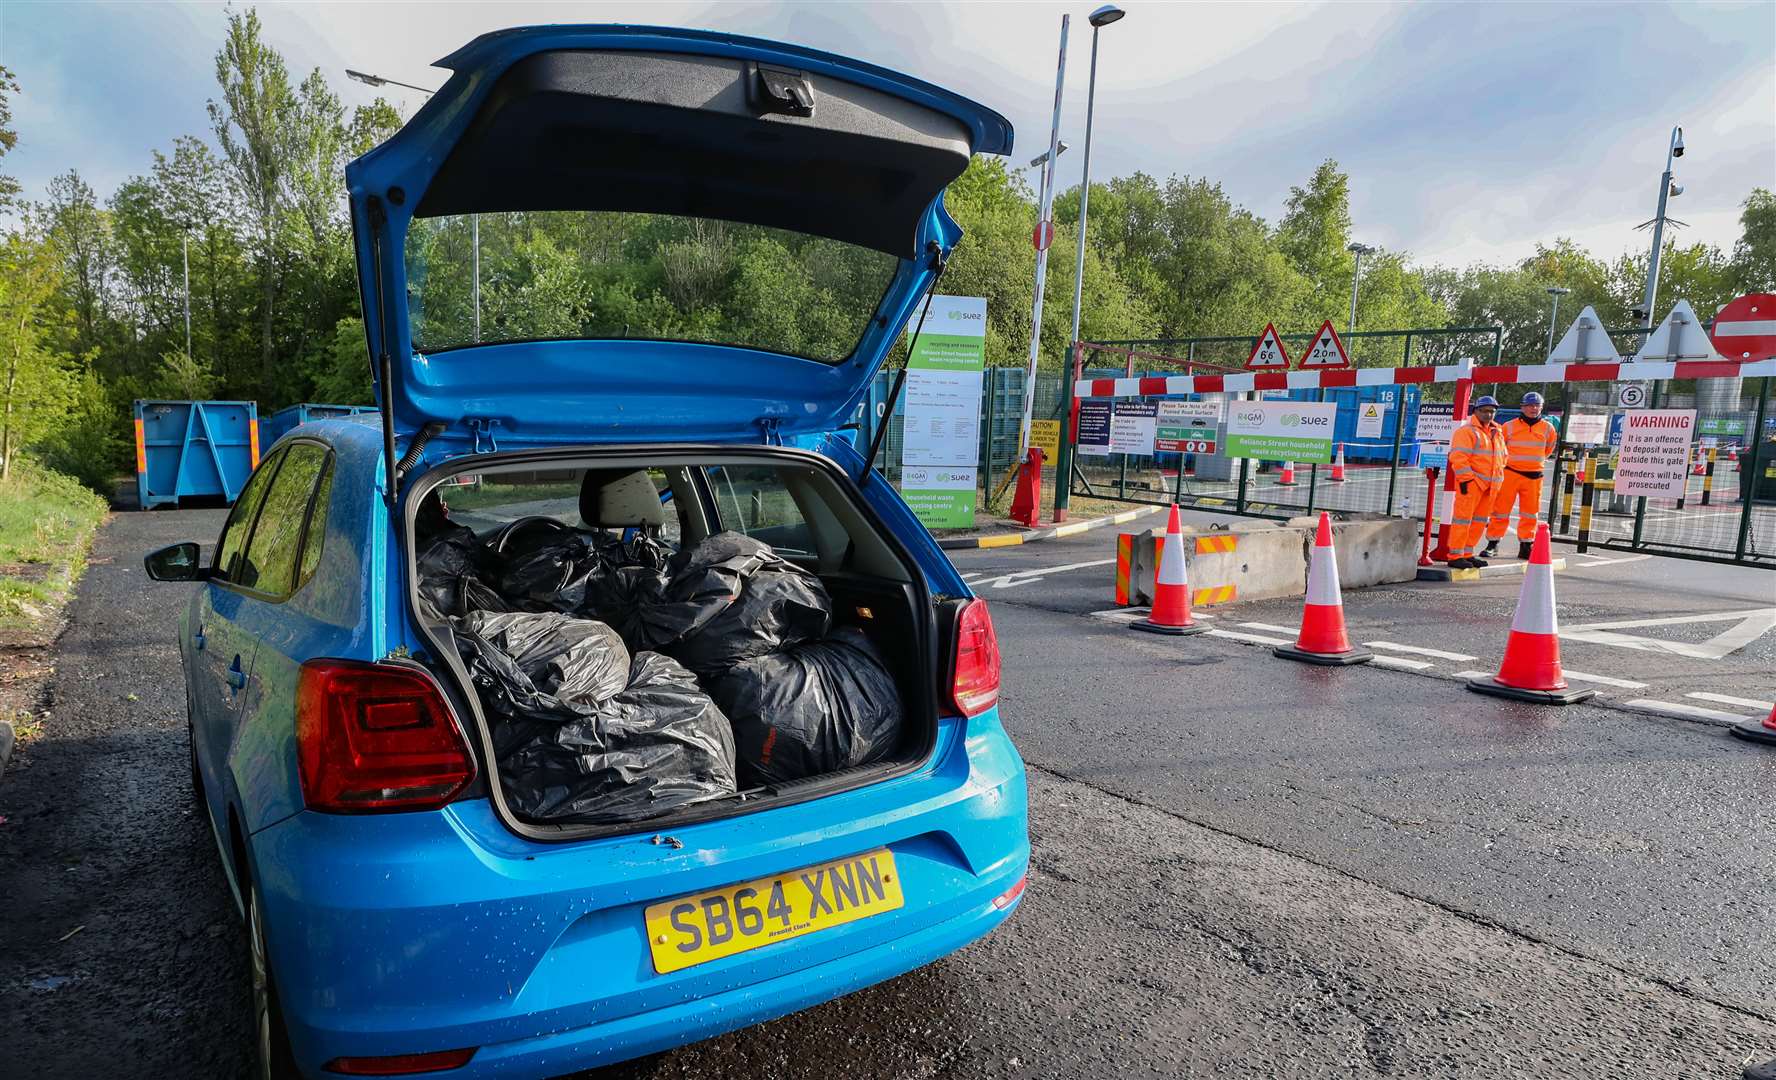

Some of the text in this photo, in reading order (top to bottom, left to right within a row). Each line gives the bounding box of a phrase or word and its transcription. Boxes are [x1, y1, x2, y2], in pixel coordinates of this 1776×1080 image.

[1380, 391, 1394, 402] 18
[1627, 390, 1637, 401] 5
[1301, 416, 1328, 425] suez
[1630, 416, 1689, 428] WARNING
[1290, 440, 1325, 449] household
[1271, 450, 1300, 458] recycling
[1633, 446, 1660, 455] deposit
[1620, 469, 1654, 478] Offenders
[1628, 481, 1670, 490] prosecuted
[670, 857, 886, 952] SB64 XNN
